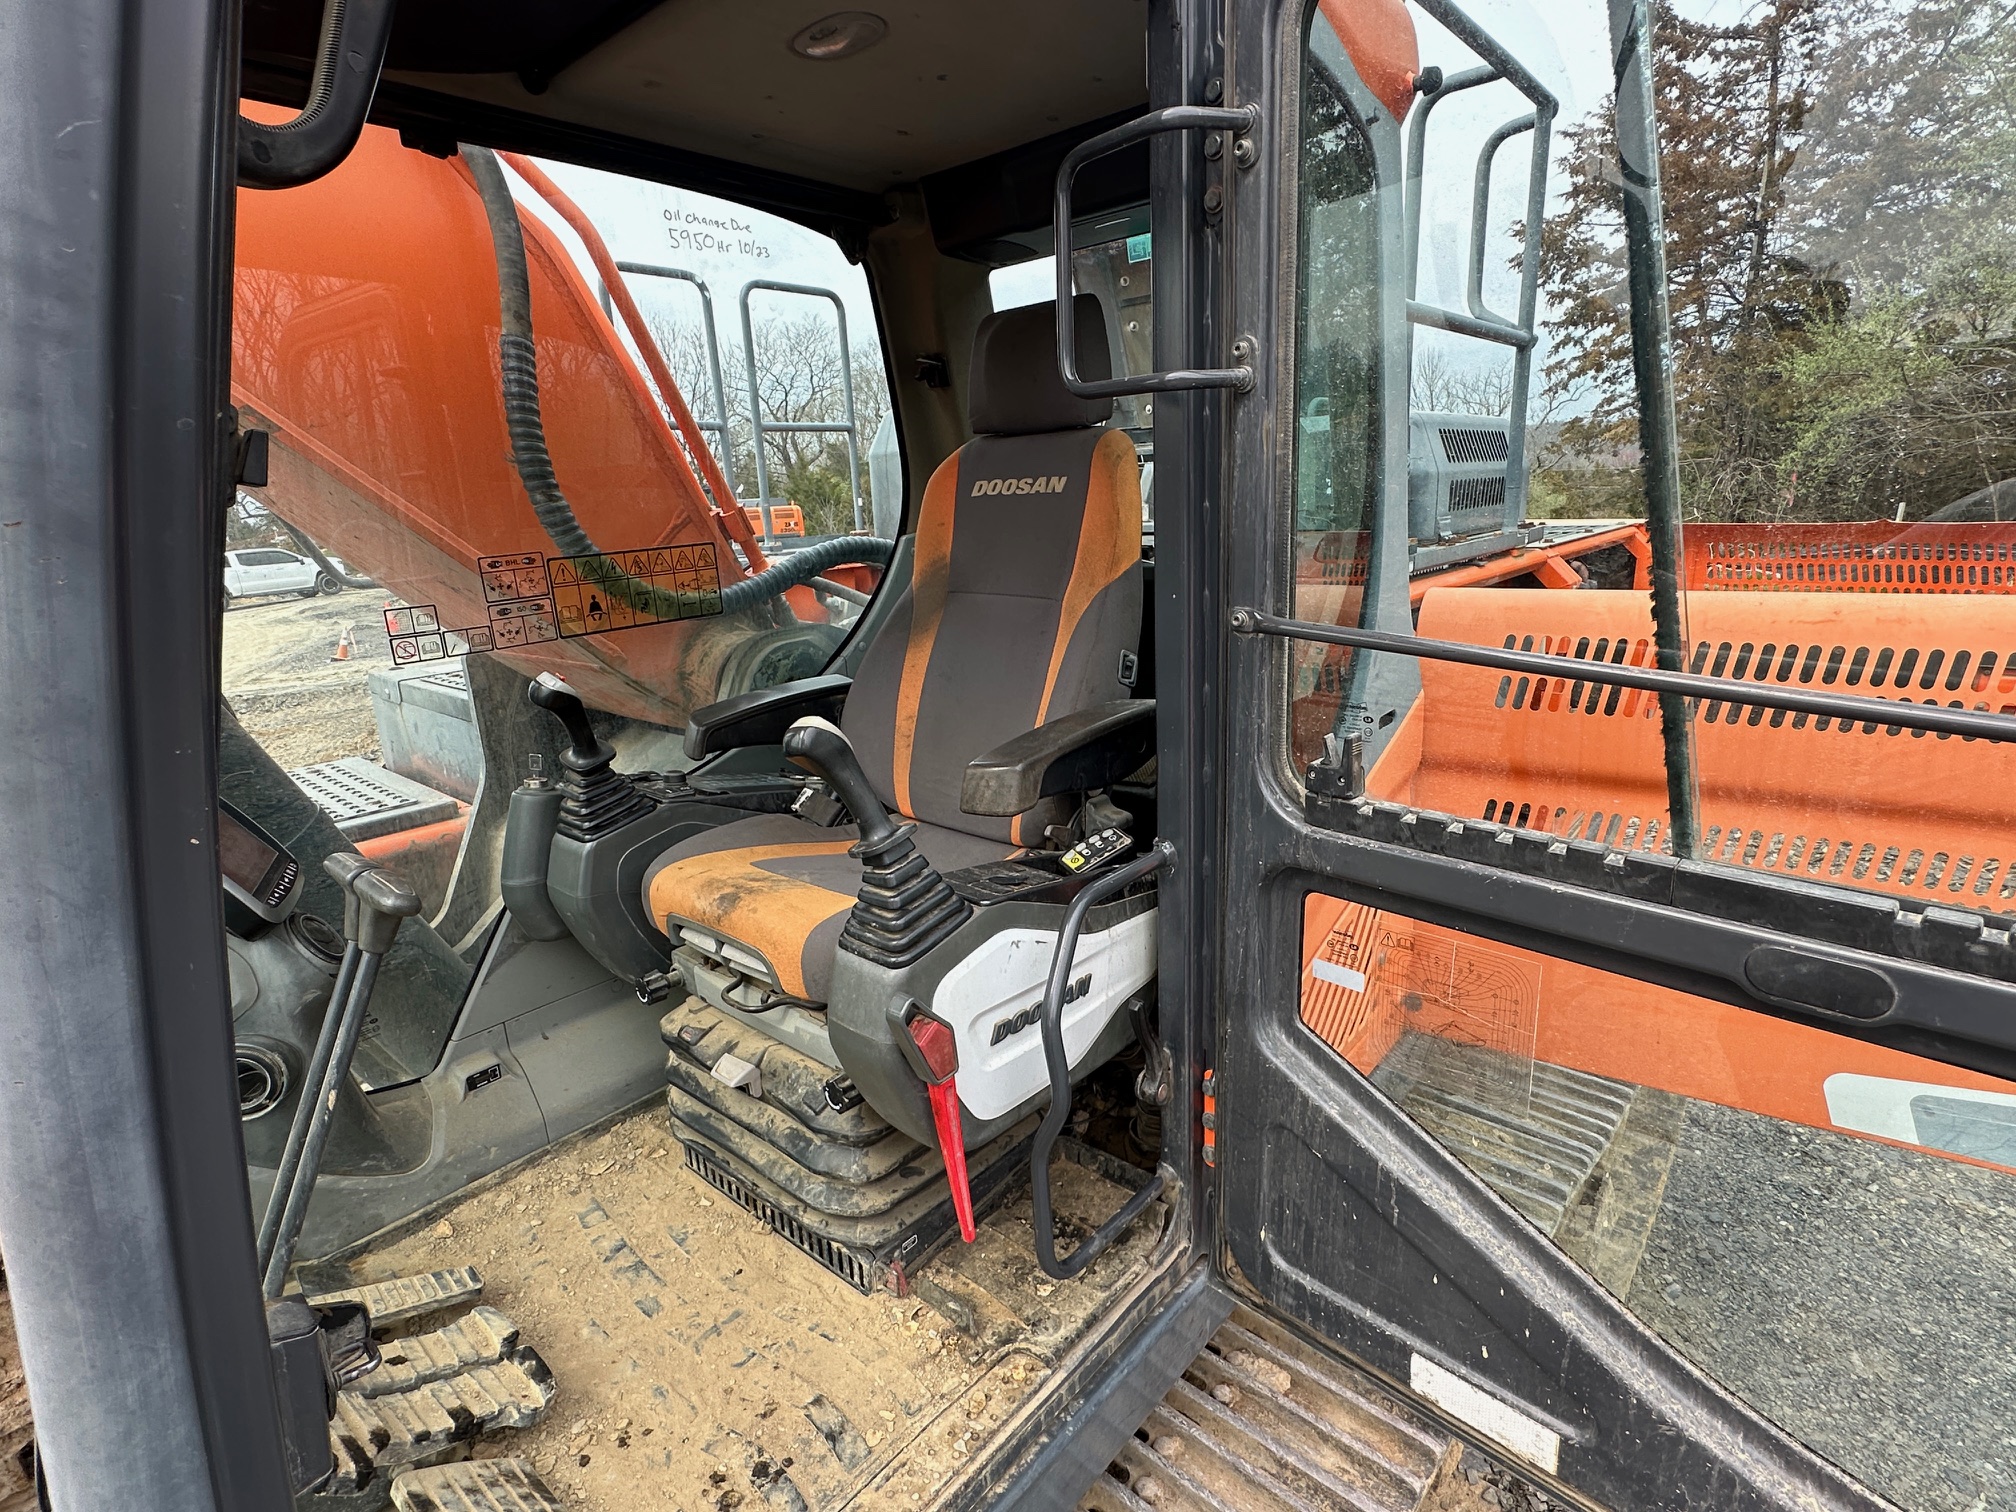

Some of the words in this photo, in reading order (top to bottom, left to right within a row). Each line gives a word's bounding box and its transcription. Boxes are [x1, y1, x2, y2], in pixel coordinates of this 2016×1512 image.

[663, 209, 681, 221] Oil
[730, 218, 752, 233] Due
[668, 228, 715, 251] 5950
[717, 240, 733, 253] Hr
[738, 239, 770, 258] 10/23
[971, 476, 1068, 497] DOOSAN
[990, 972, 1092, 1047] DOOAN
